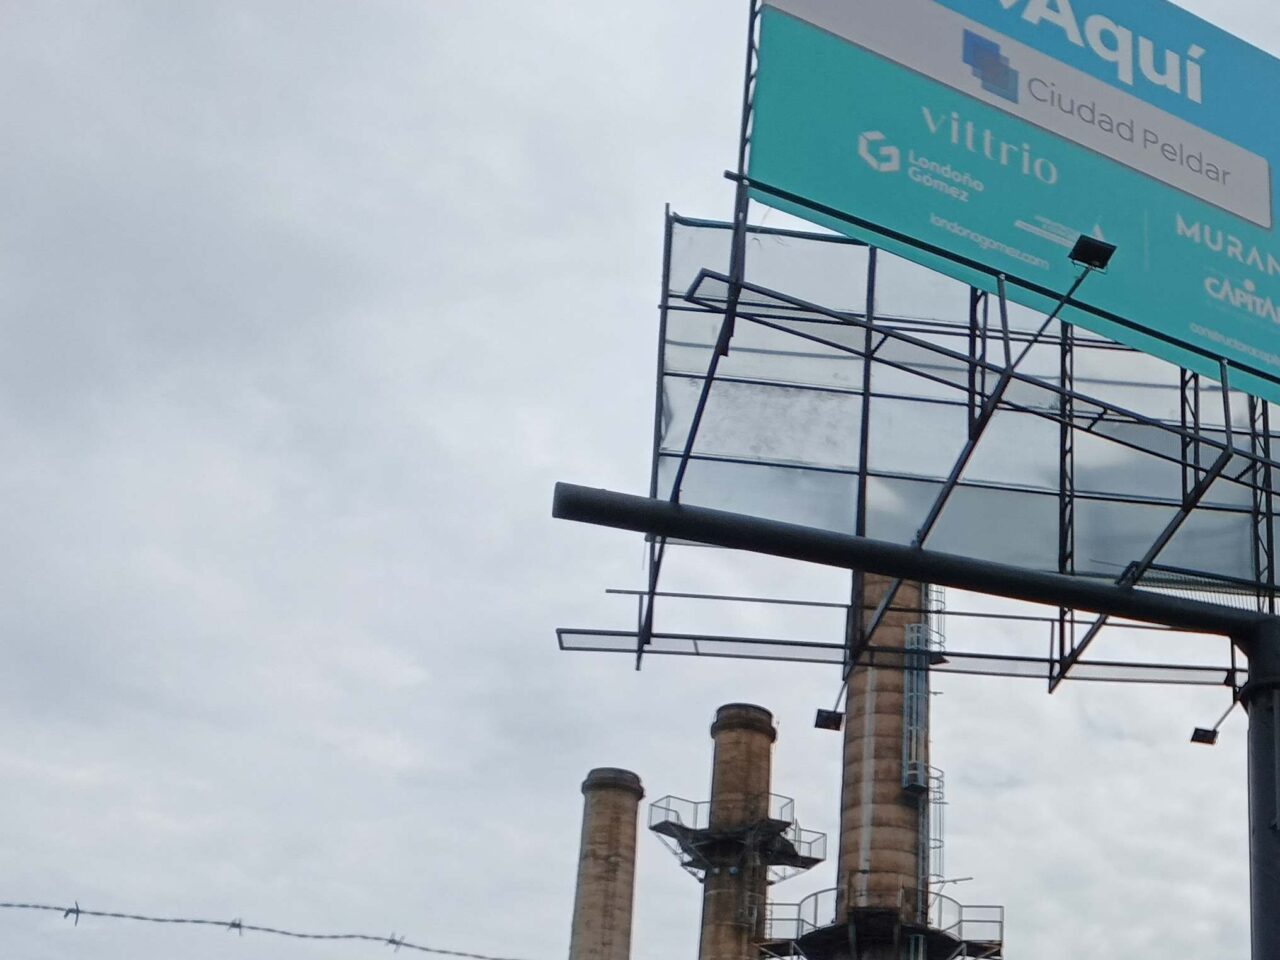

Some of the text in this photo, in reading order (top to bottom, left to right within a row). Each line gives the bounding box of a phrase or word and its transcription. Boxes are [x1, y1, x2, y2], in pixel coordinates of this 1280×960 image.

[1027, 76, 1232, 186] Ciudad Peldar
[907, 166, 970, 203] Gómez
[908, 149, 985, 192] Londoño
